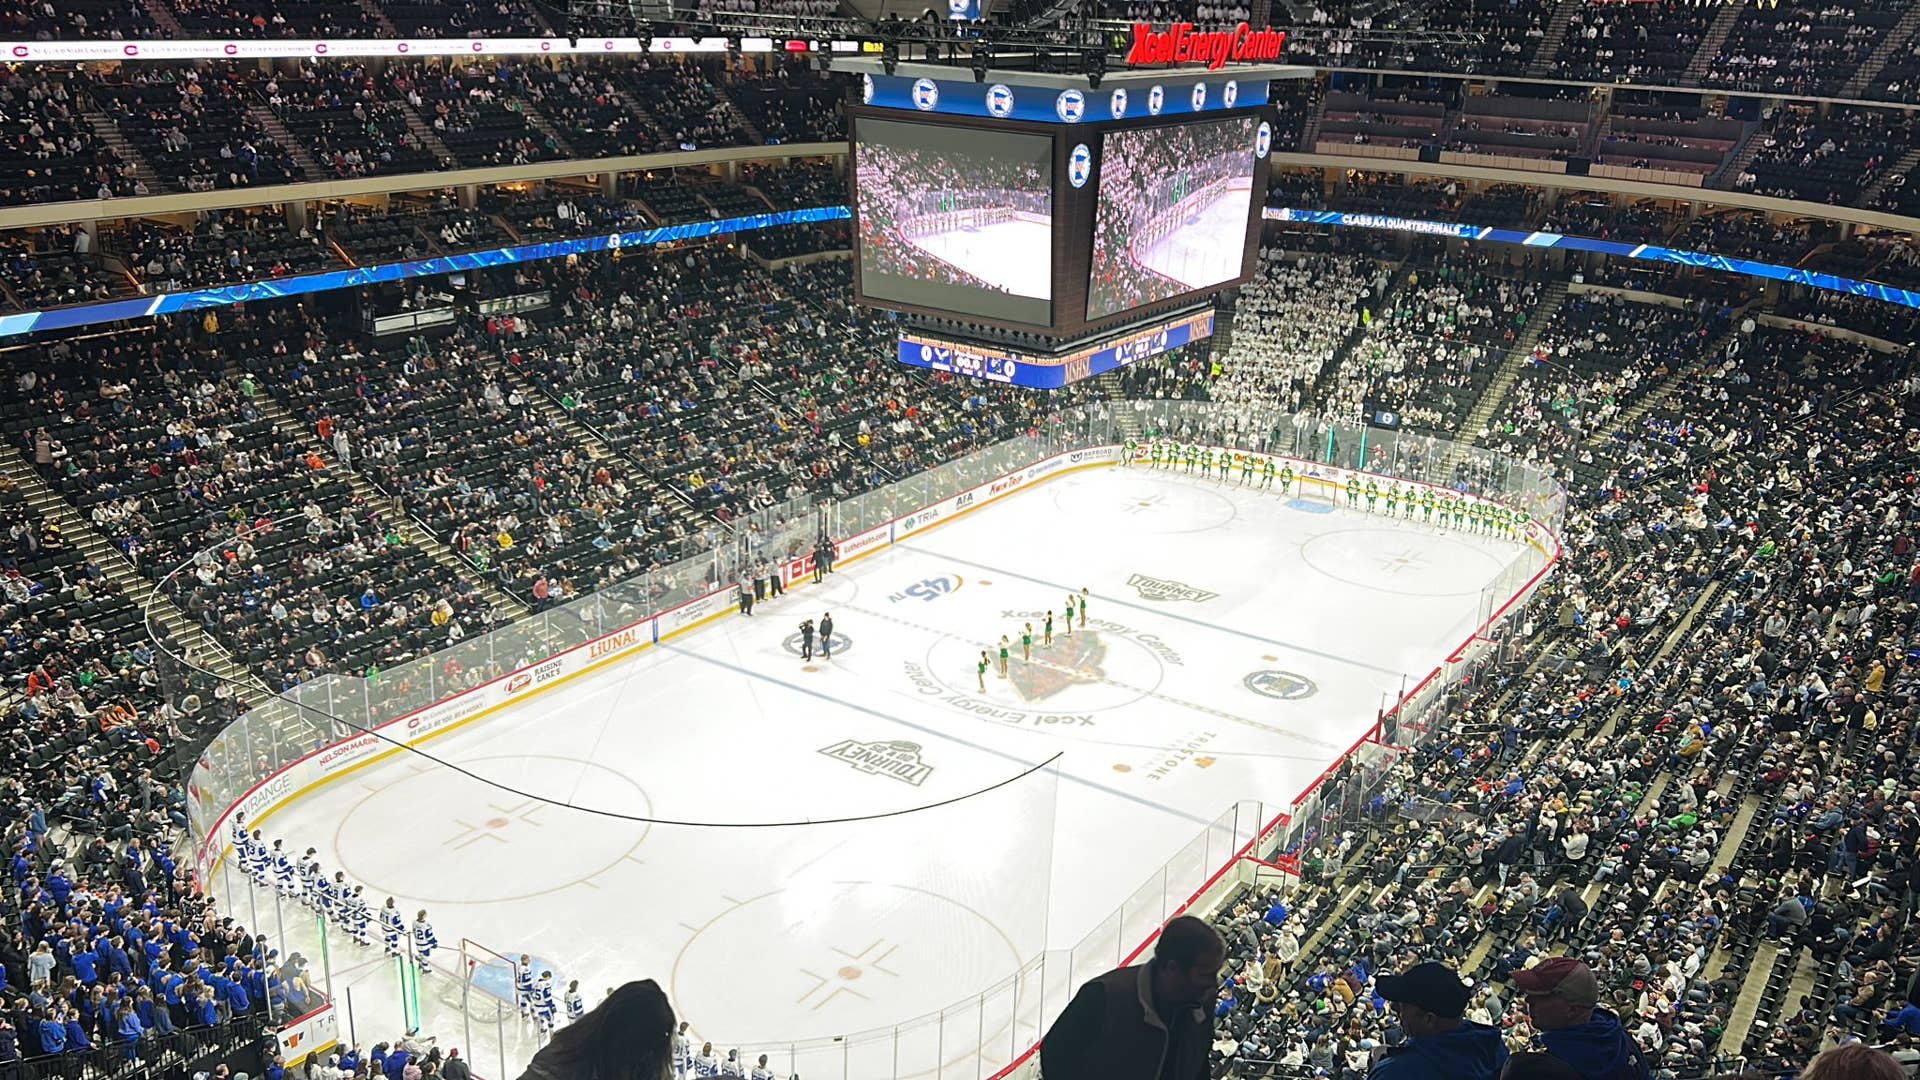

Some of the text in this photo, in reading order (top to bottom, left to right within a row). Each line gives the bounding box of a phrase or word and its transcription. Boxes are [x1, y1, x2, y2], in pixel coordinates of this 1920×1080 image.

[1129, 22, 1285, 70] Xcel Energy Center
[1342, 214, 1461, 235] CLASS AA QUARTERFINALS
[956, 492, 974, 506] AFA
[917, 509, 939, 524] TRIA
[905, 574, 952, 602] 45
[1135, 577, 1209, 601] TOURNEY
[590, 629, 637, 660] LiUNA!
[1136, 633, 1185, 667] Center
[904, 661, 1096, 727] Xcel Energy Center
[319, 745, 350, 767] NELSON
[350, 737, 380, 752] MARINE
[830, 743, 926, 782] TOURNEY
